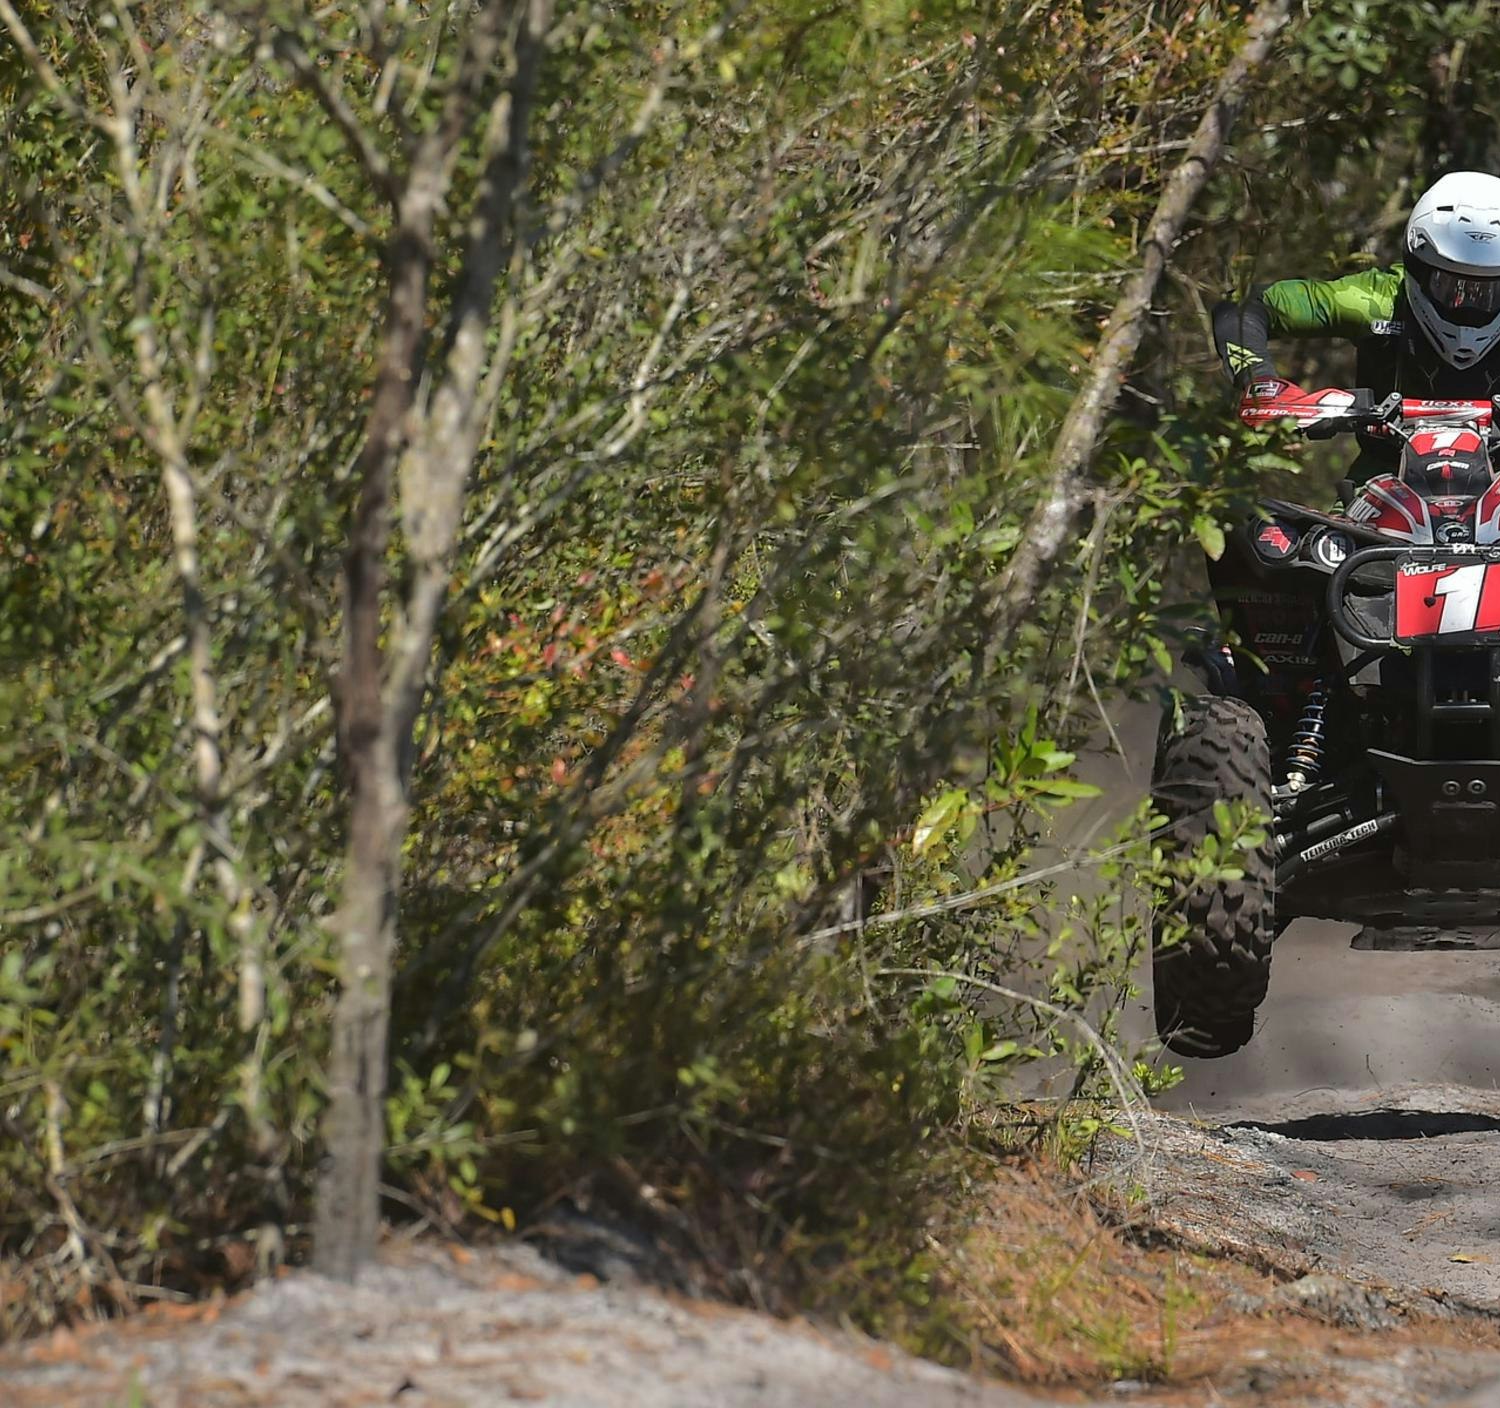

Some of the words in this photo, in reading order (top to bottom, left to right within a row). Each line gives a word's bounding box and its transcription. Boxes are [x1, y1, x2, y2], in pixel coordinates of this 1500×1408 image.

[1403, 563, 1446, 576] WOLFE
[1434, 564, 1486, 634] 1
[1350, 821, 1376, 838] TECH
